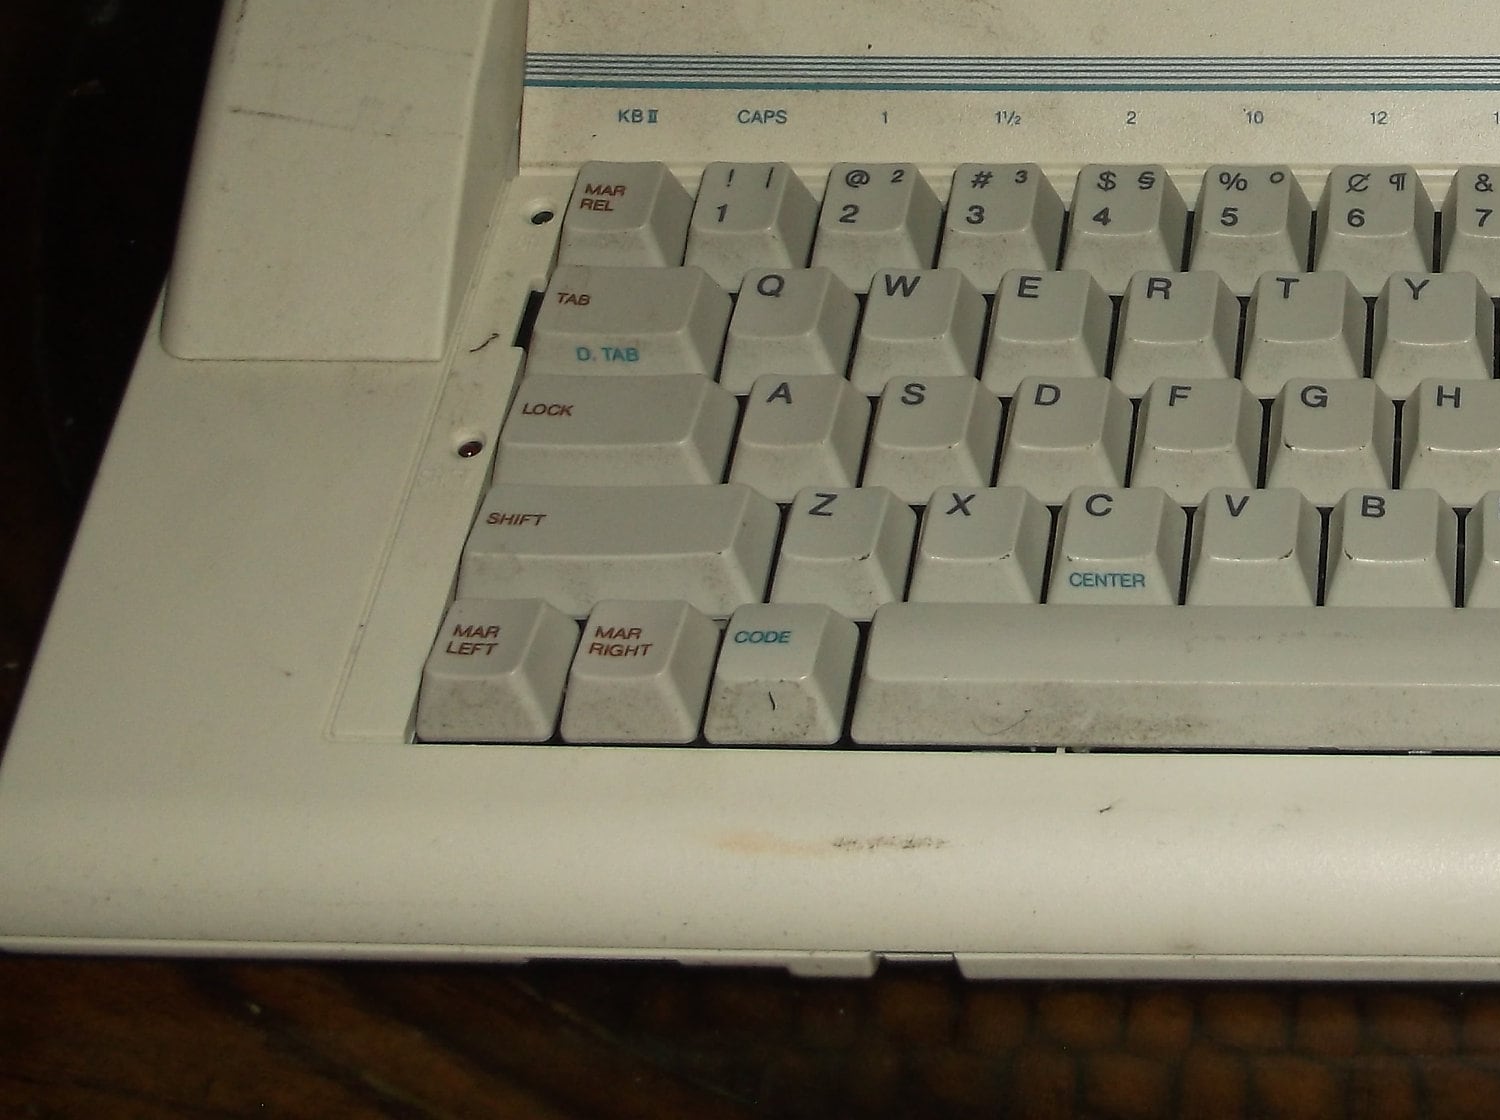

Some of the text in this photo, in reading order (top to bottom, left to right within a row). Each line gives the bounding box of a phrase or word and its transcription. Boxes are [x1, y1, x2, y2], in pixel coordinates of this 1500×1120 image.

[618, 109, 643, 123] KB
[737, 110, 787, 124] CAPS
[882, 111, 887, 124] 1
[1127, 111, 1136, 124] 2
[1246, 111, 1264, 125] 10
[1371, 111, 1387, 125] 12
[845, 170, 904, 188] @ 2
[971, 170, 1027, 189] # 3
[1097, 171, 1116, 192] $
[1219, 172, 1247, 191] %
[1475, 174, 1493, 192] &
[585, 184, 626, 196] MAR
[580, 198, 616, 211] REL
[717, 204, 727, 222] 1
[839, 204, 859, 223] 2
[966, 205, 984, 224] 3
[1093, 207, 1111, 226] 4
[1221, 207, 1238, 226] 5
[1347, 209, 1365, 227] 6
[1476, 209, 1492, 227] 7
[757, 275, 784, 297] Q
[885, 274, 920, 297] W
[1018, 276, 1042, 298] E
[1147, 278, 1172, 299] R
[1276, 278, 1299, 299] T
[1405, 278, 1429, 300] Y
[558, 292, 590, 306] TAB
[576, 347, 639, 362] D. TAB
[766, 382, 792, 404] A
[901, 383, 925, 405] S
[1034, 384, 1060, 406] D
[1169, 386, 1191, 406] F
[1301, 386, 1328, 408] G
[1437, 386, 1460, 408] H
[522, 403, 573, 416] LOCK
[809, 493, 837, 516] Z
[946, 493, 975, 516] X
[1086, 494, 1113, 516] C
[1225, 495, 1249, 517] V
[1362, 495, 1385, 518] B
[486, 513, 547, 526] SHIFT
[1069, 572, 1145, 588] CENTER
[453, 624, 500, 638] MAR
[595, 626, 642, 640] MAR
[734, 631, 791, 643] CODE
[446, 641, 498, 655] LEFT
[589, 642, 653, 657] RIGHT
